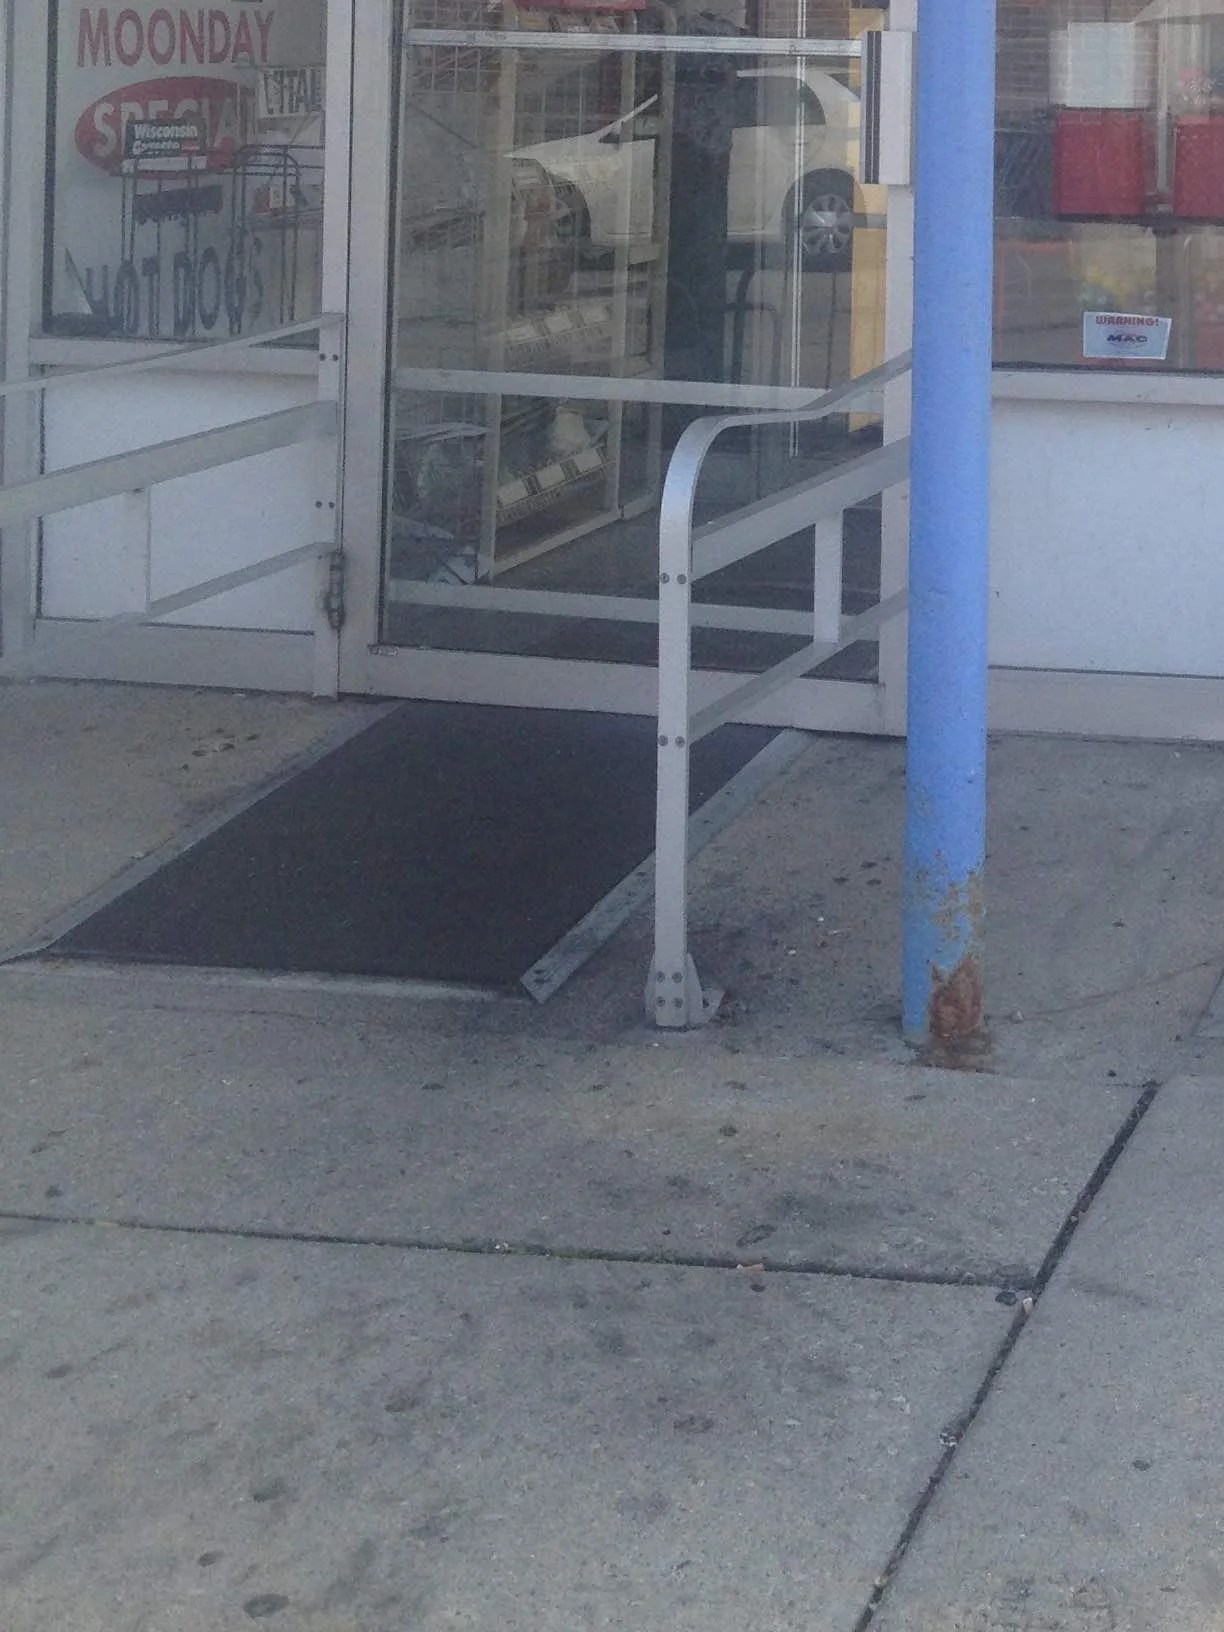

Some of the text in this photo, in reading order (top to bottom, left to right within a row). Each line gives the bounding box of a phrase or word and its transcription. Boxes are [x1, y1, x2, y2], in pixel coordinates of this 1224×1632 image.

[77, 8, 276, 67] MOONDAY
[134, 122, 198, 139] Wisconsin
[1096, 314, 1159, 327] WARNING!
